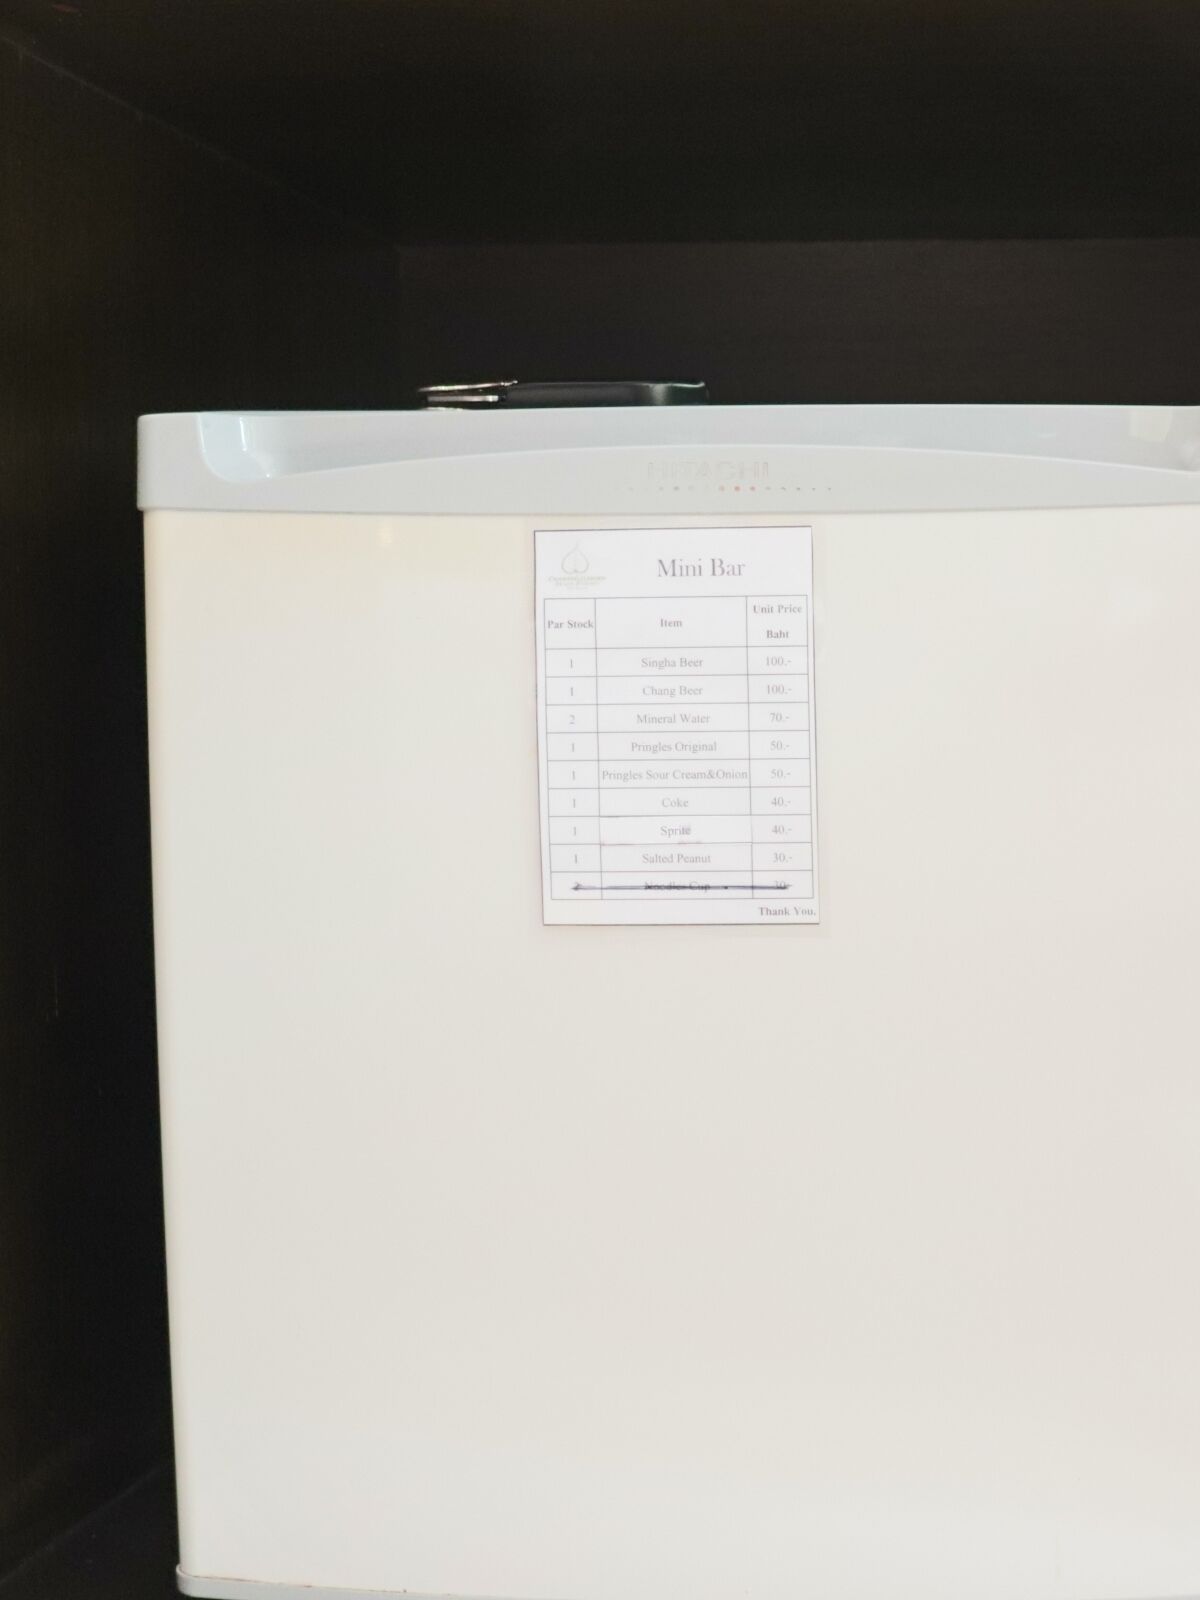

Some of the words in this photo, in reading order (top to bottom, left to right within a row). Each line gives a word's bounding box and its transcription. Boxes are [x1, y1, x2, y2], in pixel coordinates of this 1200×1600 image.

[657, 558, 702, 577] Mini
[710, 558, 746, 577] Bar
[752, 604, 774, 614] Unit
[777, 603, 803, 615] Price
[547, 619, 565, 630] Par
[567, 619, 594, 629] Stock
[660, 617, 683, 628] Item
[765, 629, 789, 639] Baht
[640, 657, 677, 671] Singha
[679, 657, 703, 668] Beer
[642, 685, 677, 699] Chang
[679, 685, 704, 696] Beer
[636, 713, 677, 724] Mineral
[679, 713, 711, 724] Water
[631, 741, 673, 755] Pringles
[674, 741, 717, 754] Original
[602, 769, 644, 783] Pringles
[645, 769, 671, 780] Sour
[672, 768, 748, 780] Cream&Onion
[661, 797, 689, 808] Coke
[641, 853, 674, 865] Salted
[676, 852, 712, 864] Peanut
[758, 906, 790, 917] Thank
